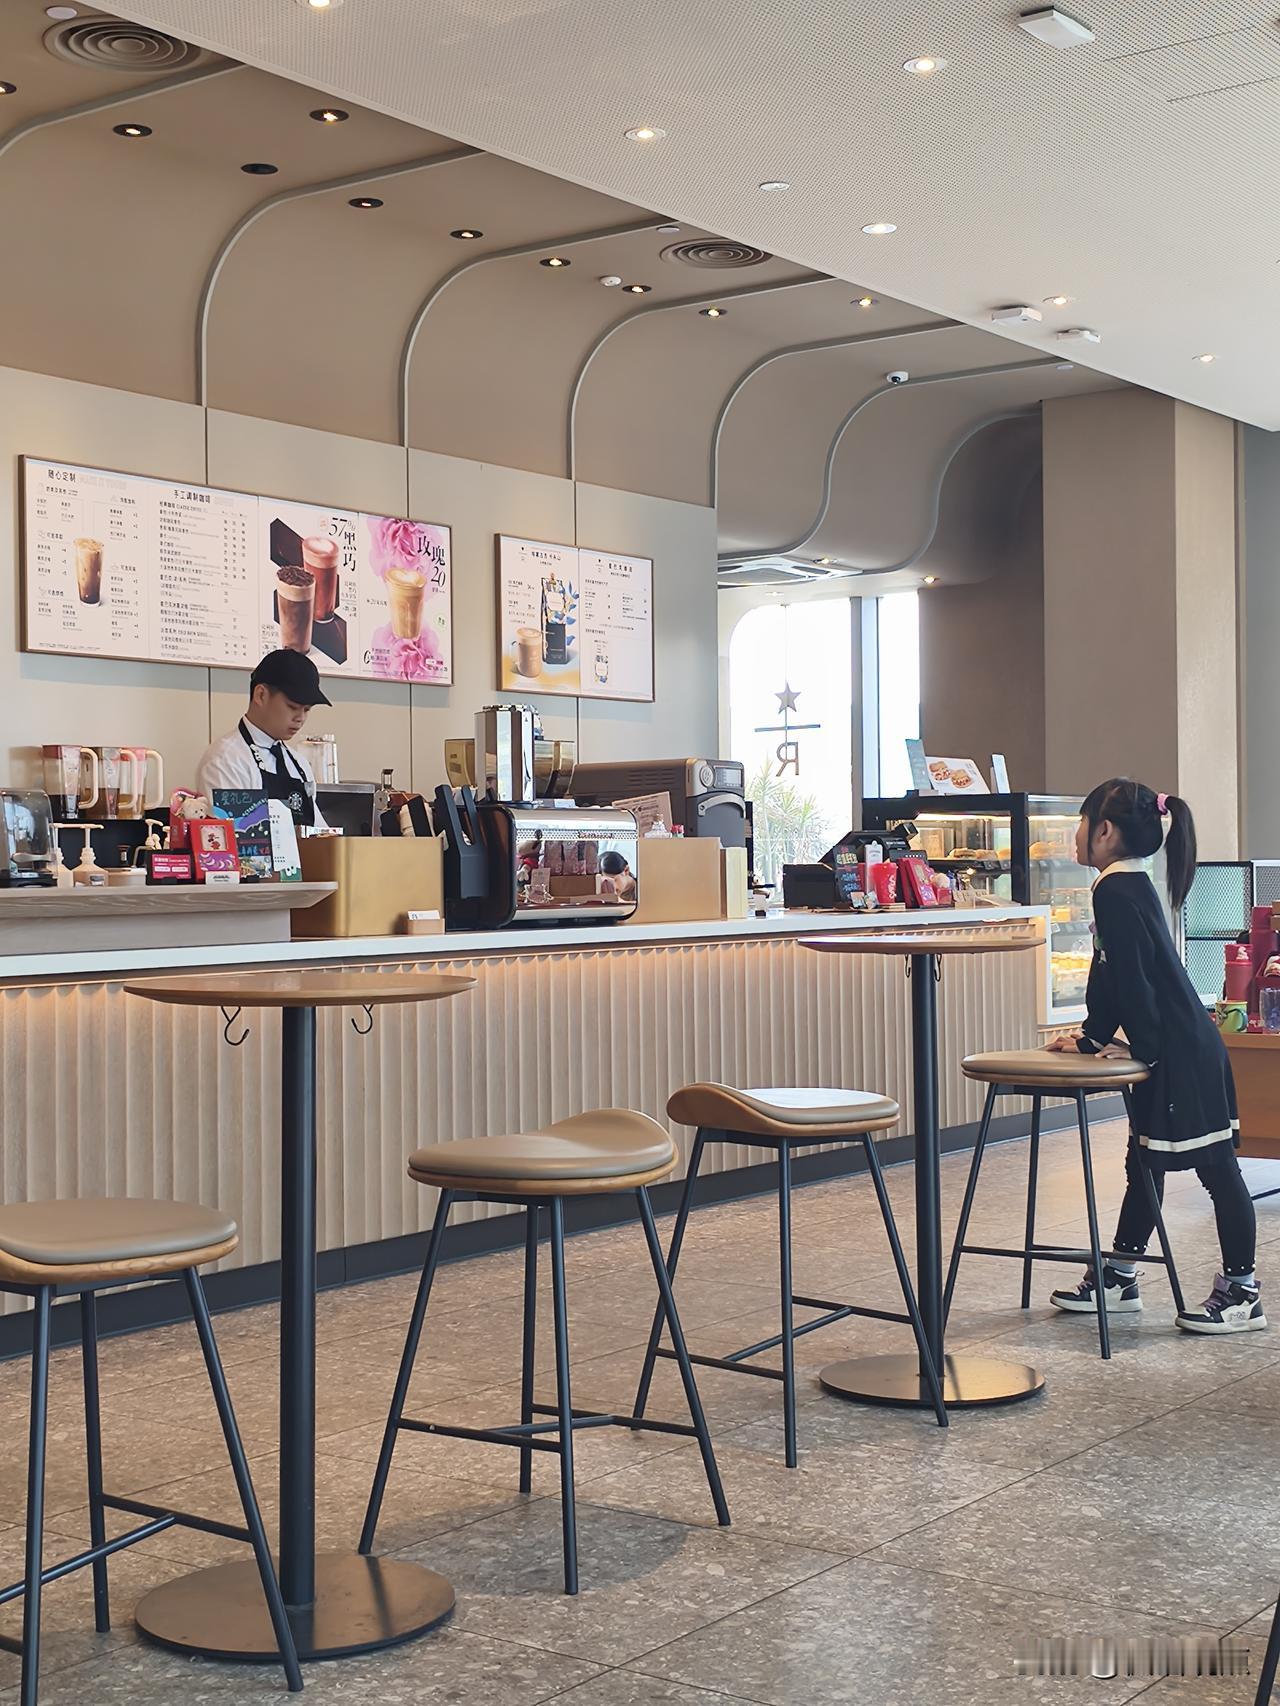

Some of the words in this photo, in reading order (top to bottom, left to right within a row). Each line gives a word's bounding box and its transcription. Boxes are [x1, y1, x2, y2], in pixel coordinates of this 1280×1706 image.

[174, 489, 211, 504] 手工调制咖啡
[343, 532, 357, 572] 黑巧
[417, 535, 446, 566] 玫瑰
